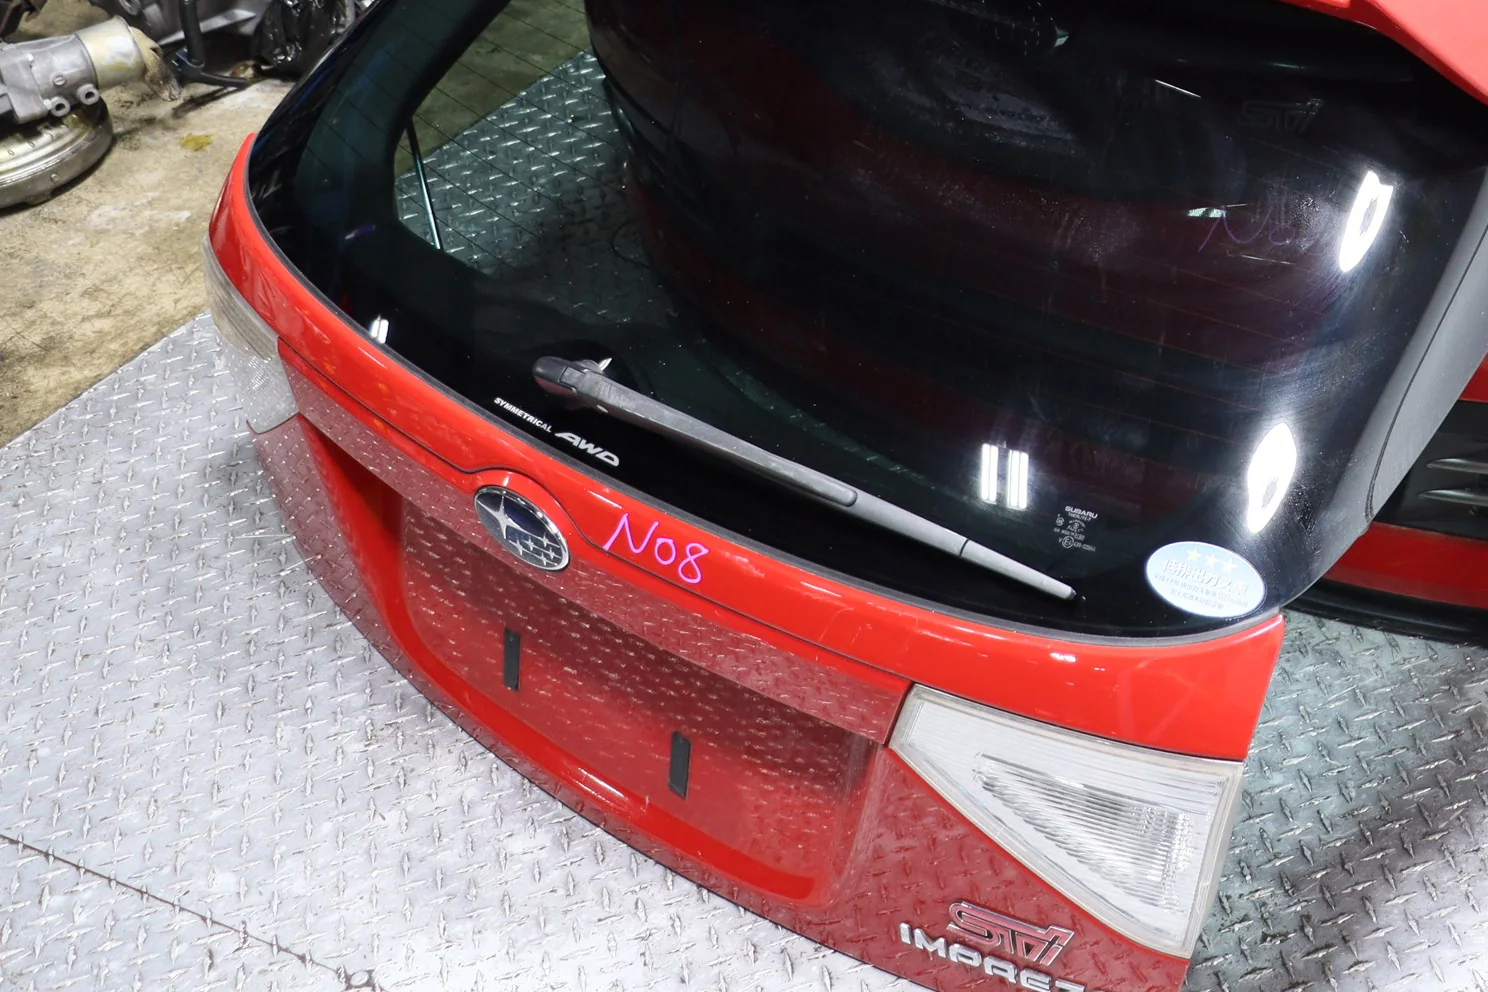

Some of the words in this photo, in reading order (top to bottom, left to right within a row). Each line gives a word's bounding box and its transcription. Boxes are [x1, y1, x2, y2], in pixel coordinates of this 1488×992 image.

[493, 397, 553, 433] SYMMETRICAL
[554, 431, 620, 467] AWD
[1065, 505, 1098, 519] SUBARU
[602, 513, 710, 584] N08
[900, 922, 1106, 992] IMPRE
